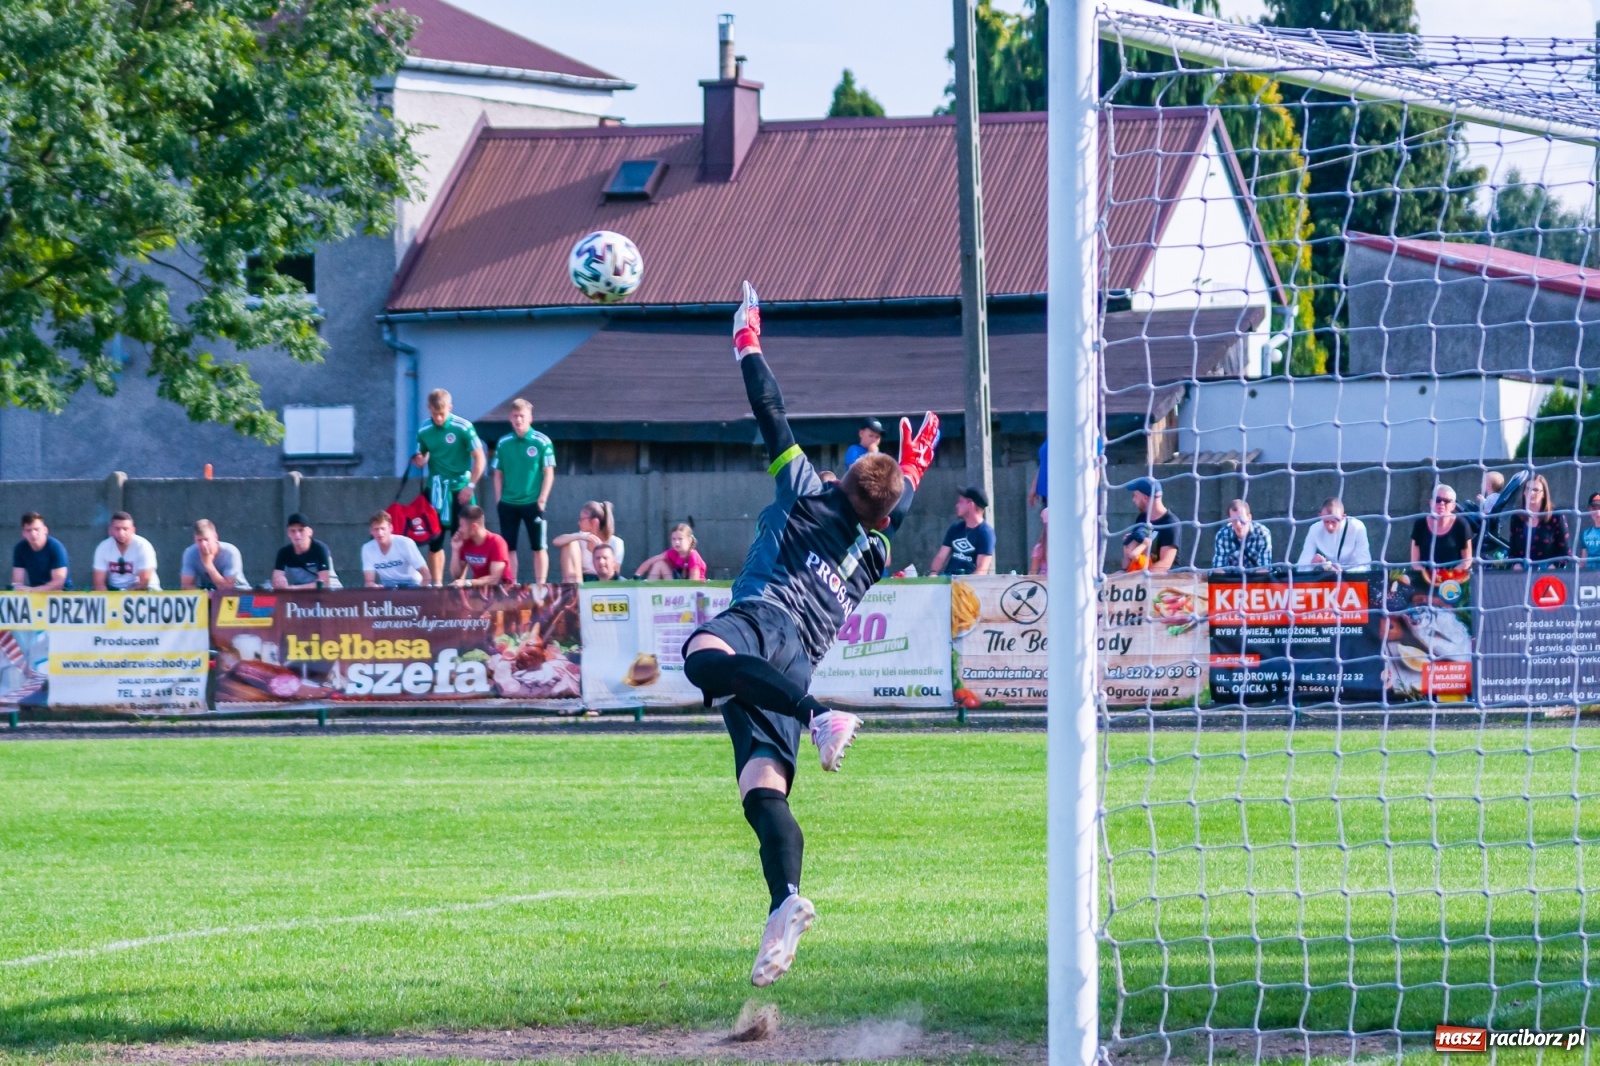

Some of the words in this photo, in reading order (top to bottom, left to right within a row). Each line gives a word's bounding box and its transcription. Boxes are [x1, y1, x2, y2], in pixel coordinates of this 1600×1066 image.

[1215, 587, 1361, 610] KREWETKA
[48, 597, 105, 624] DRZWI
[123, 596, 198, 624] SCHODY
[286, 602, 359, 618] Producent
[1555, 620, 1592, 629] krusyw
[1215, 628, 1237, 636] RYBY
[94, 635, 160, 646] Producent
[983, 629, 1016, 653] The
[286, 633, 432, 661] kiełbasa
[61, 657, 201, 669] www.oknadrzwischody.pl
[1530, 657, 1557, 666] oboty
[345, 648, 491, 695] szefa
[963, 666, 1033, 679] Zamówienia
[1127, 666, 1141, 677] 32
[1167, 666, 1183, 678] 69
[1185, 666, 1202, 678] 69
[1301, 673, 1315, 681] tel.
[1317, 673, 1326, 681] 32
[1342, 673, 1353, 681] 22
[1354, 673, 1364, 681] 32
[985, 688, 1023, 698] 47-451
[1171, 686, 1180, 697] 2
